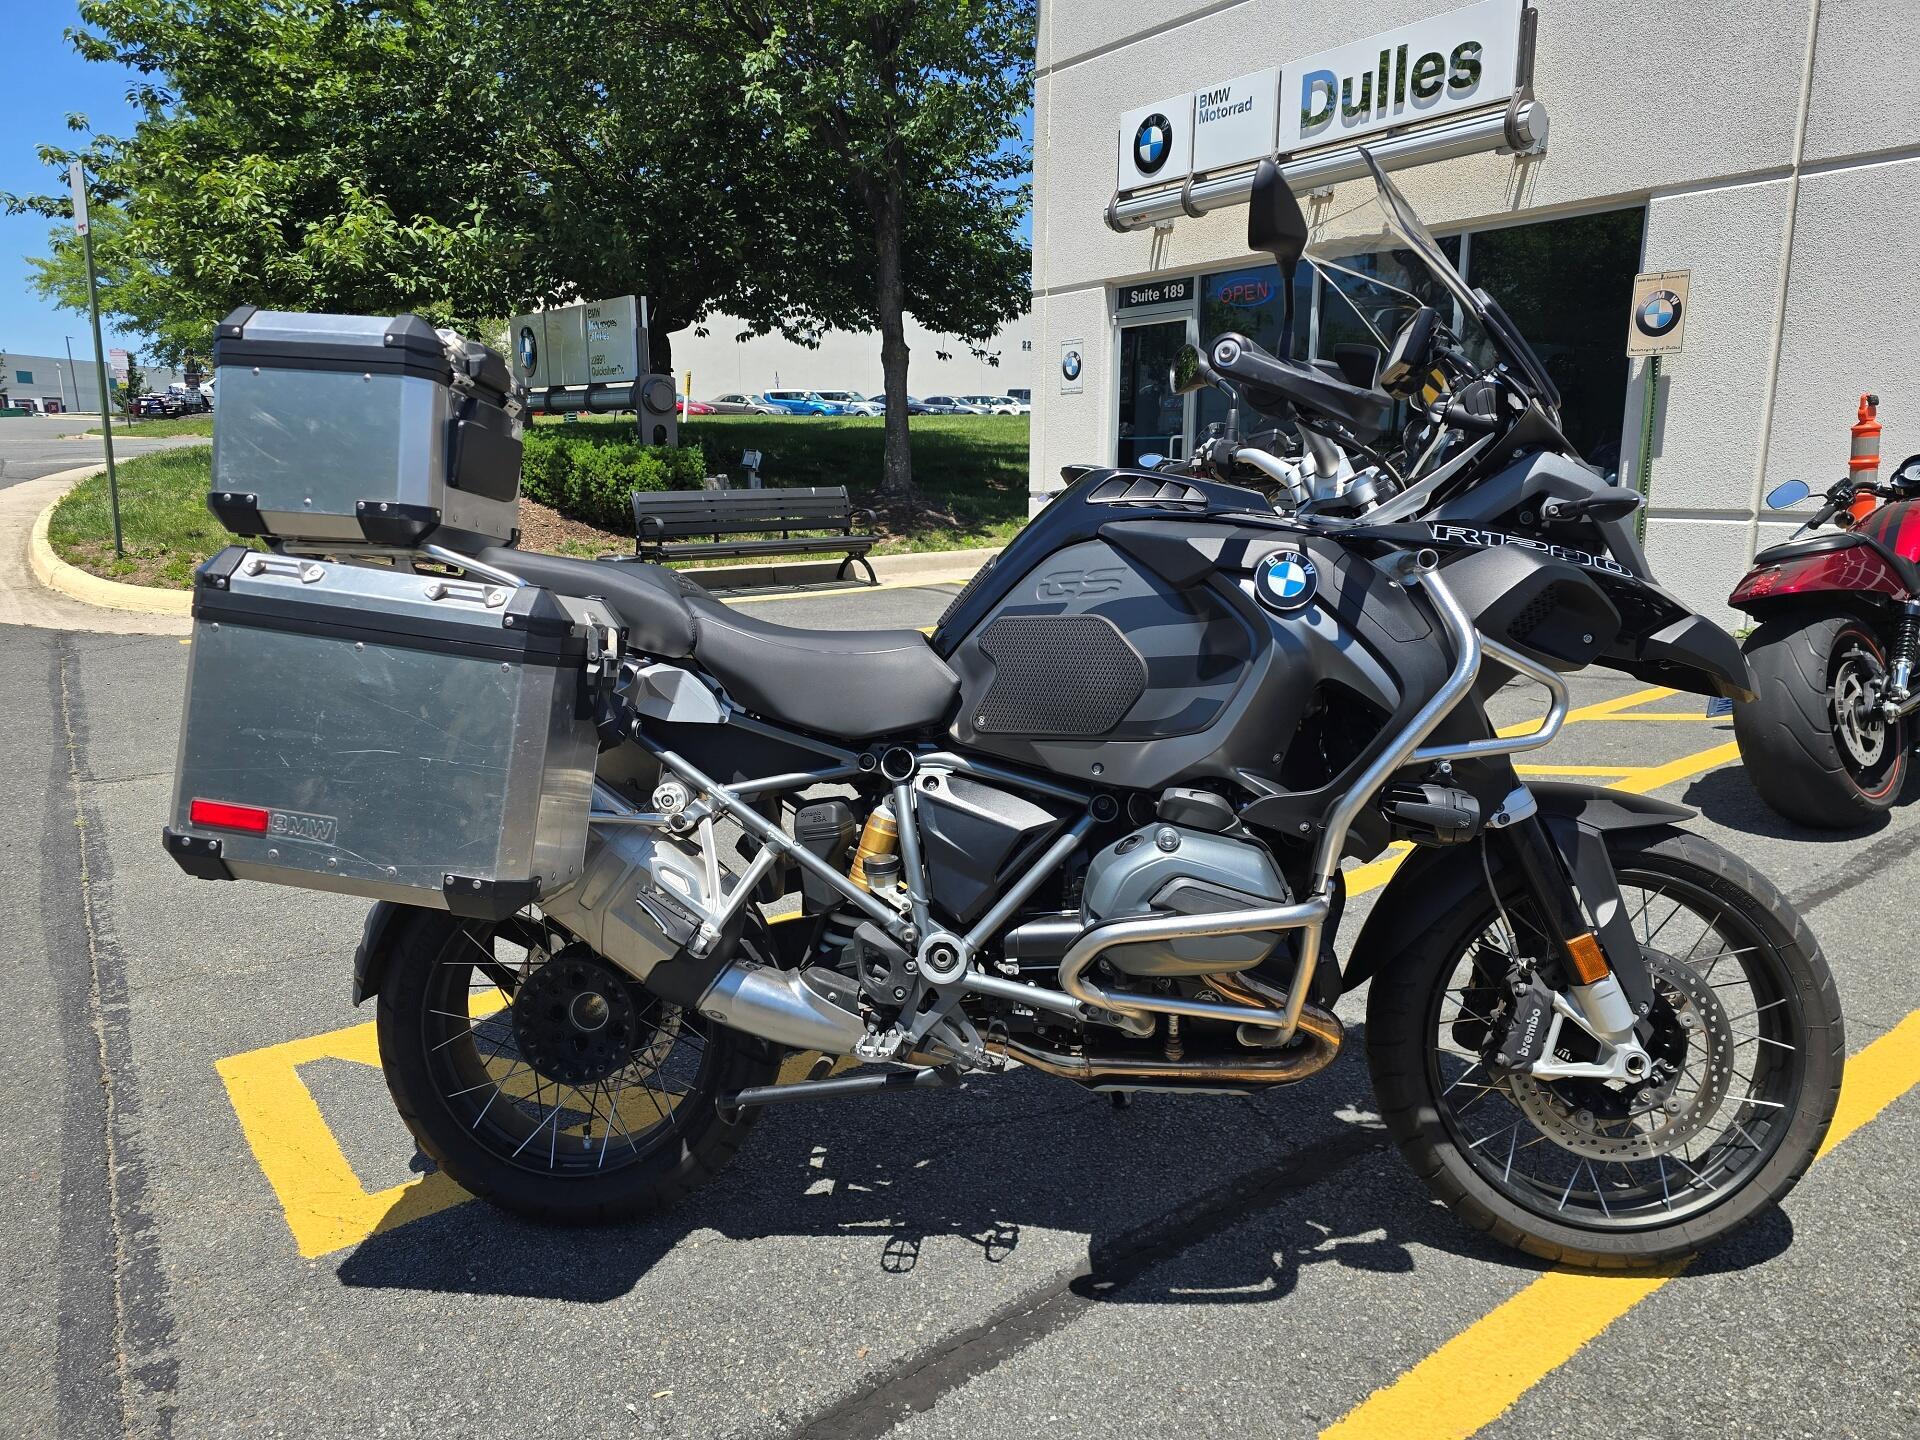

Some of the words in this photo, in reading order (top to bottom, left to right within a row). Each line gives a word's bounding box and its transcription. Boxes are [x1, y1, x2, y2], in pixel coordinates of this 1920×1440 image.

[1200, 86, 1231, 109] BMW
[1300, 41, 1482, 129] Dulles
[1198, 96, 1253, 124] Motorrad
[1130, 290, 1160, 304] Suite
[1163, 283, 1185, 299] 189
[1219, 280, 1268, 304] OPEN
[1432, 524, 1634, 578] R1200
[1035, 566, 1127, 600] GS
[271, 813, 334, 841] BMW
[812, 815, 828, 823] ESA
[1516, 1008, 1542, 1057] brembo
